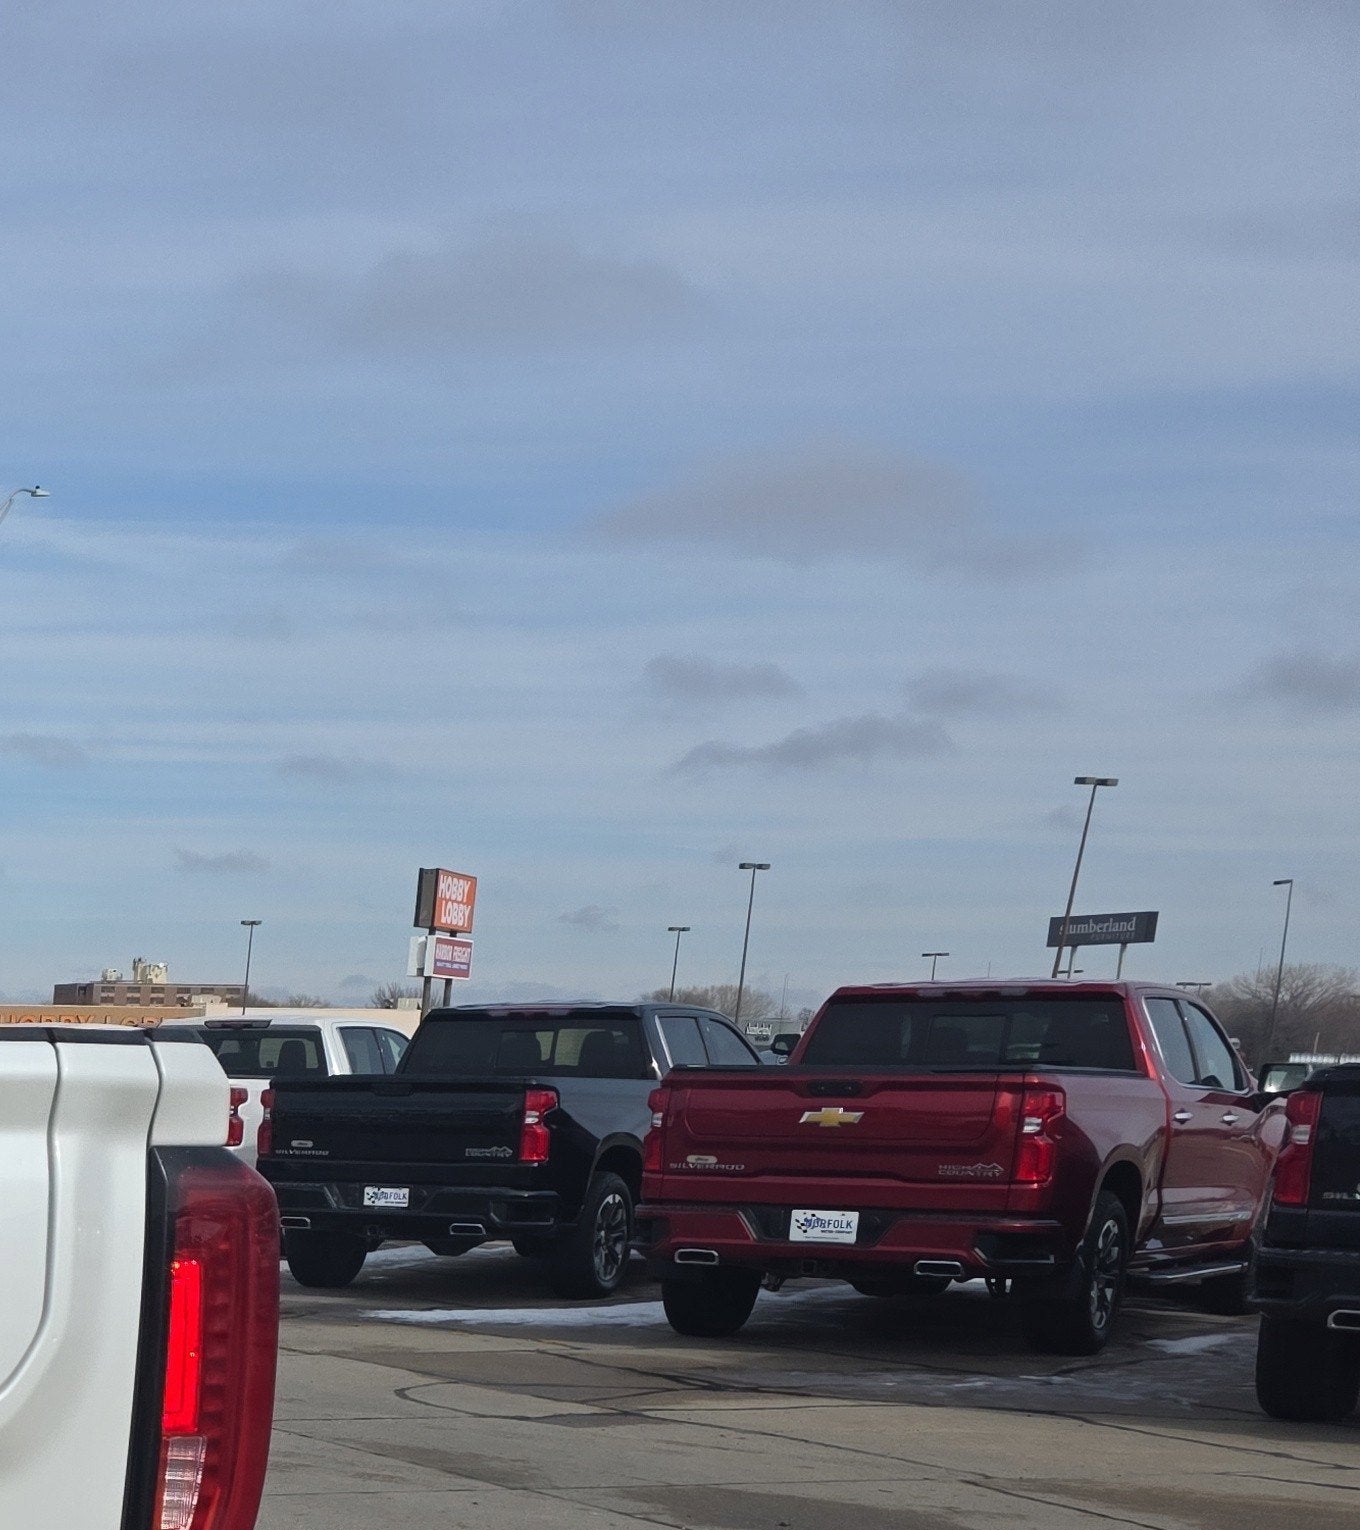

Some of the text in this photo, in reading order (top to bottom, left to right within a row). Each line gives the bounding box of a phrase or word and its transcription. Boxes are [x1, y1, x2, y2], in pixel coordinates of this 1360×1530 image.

[438, 874, 471, 902] HOBBY
[441, 901, 472, 927] LOBBY
[1059, 917, 1137, 935] umberland
